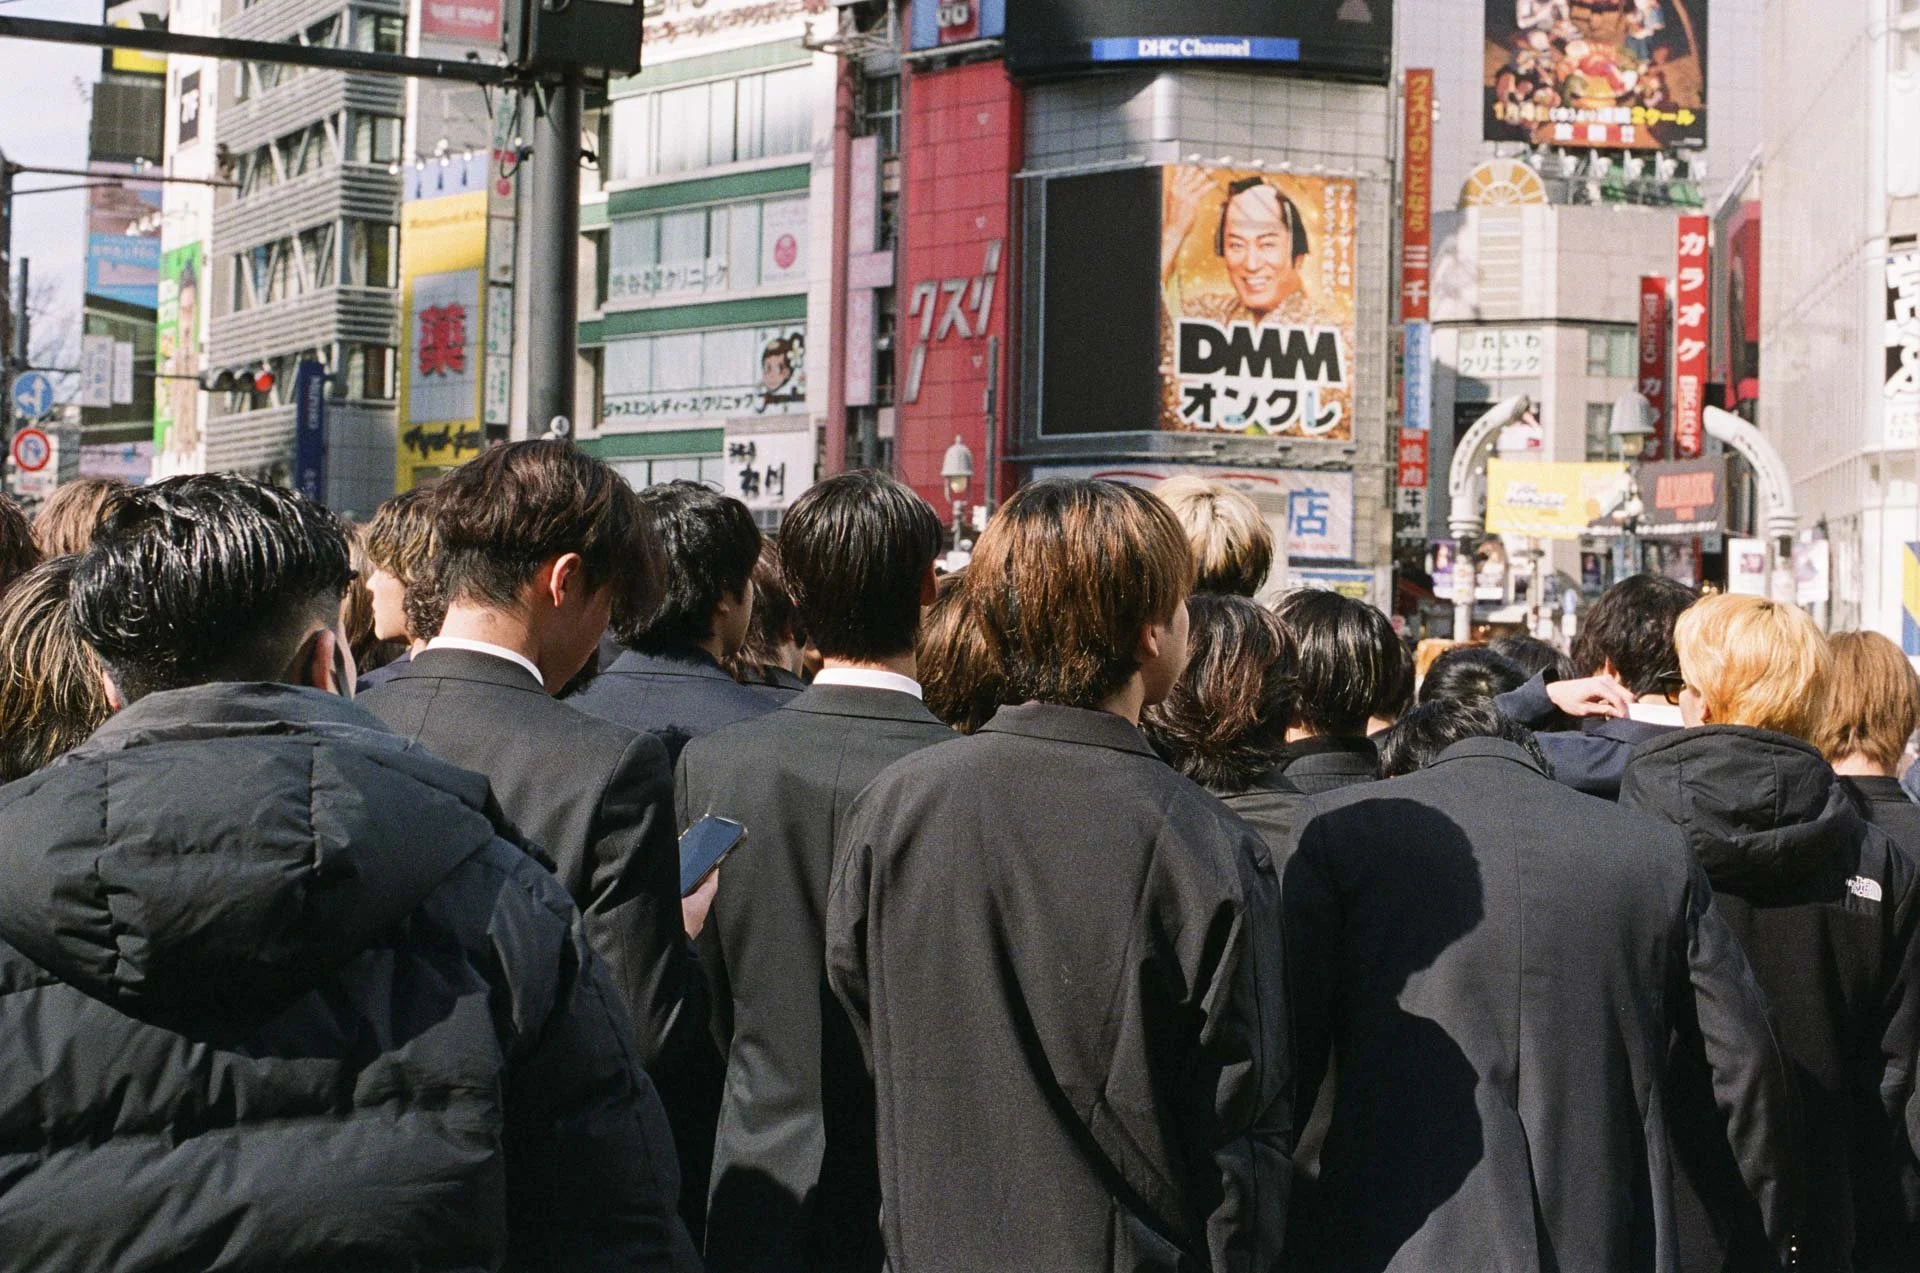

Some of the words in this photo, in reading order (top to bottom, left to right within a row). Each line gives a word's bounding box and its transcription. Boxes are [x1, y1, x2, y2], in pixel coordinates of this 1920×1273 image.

[1138, 38, 1179, 57] DHC
[1180, 38, 1250, 57] Channel
[903, 239, 1001, 404] クスリ
[1678, 232, 1706, 363] カラオケ
[418, 302, 466, 376] 薬
[1179, 320, 1342, 383] DMM
[1463, 355, 1542, 374] クリニック
[1481, 333, 1541, 350] れいわ
[1182, 383, 1336, 428] オンクレ
[1288, 486, 1330, 537] 店
